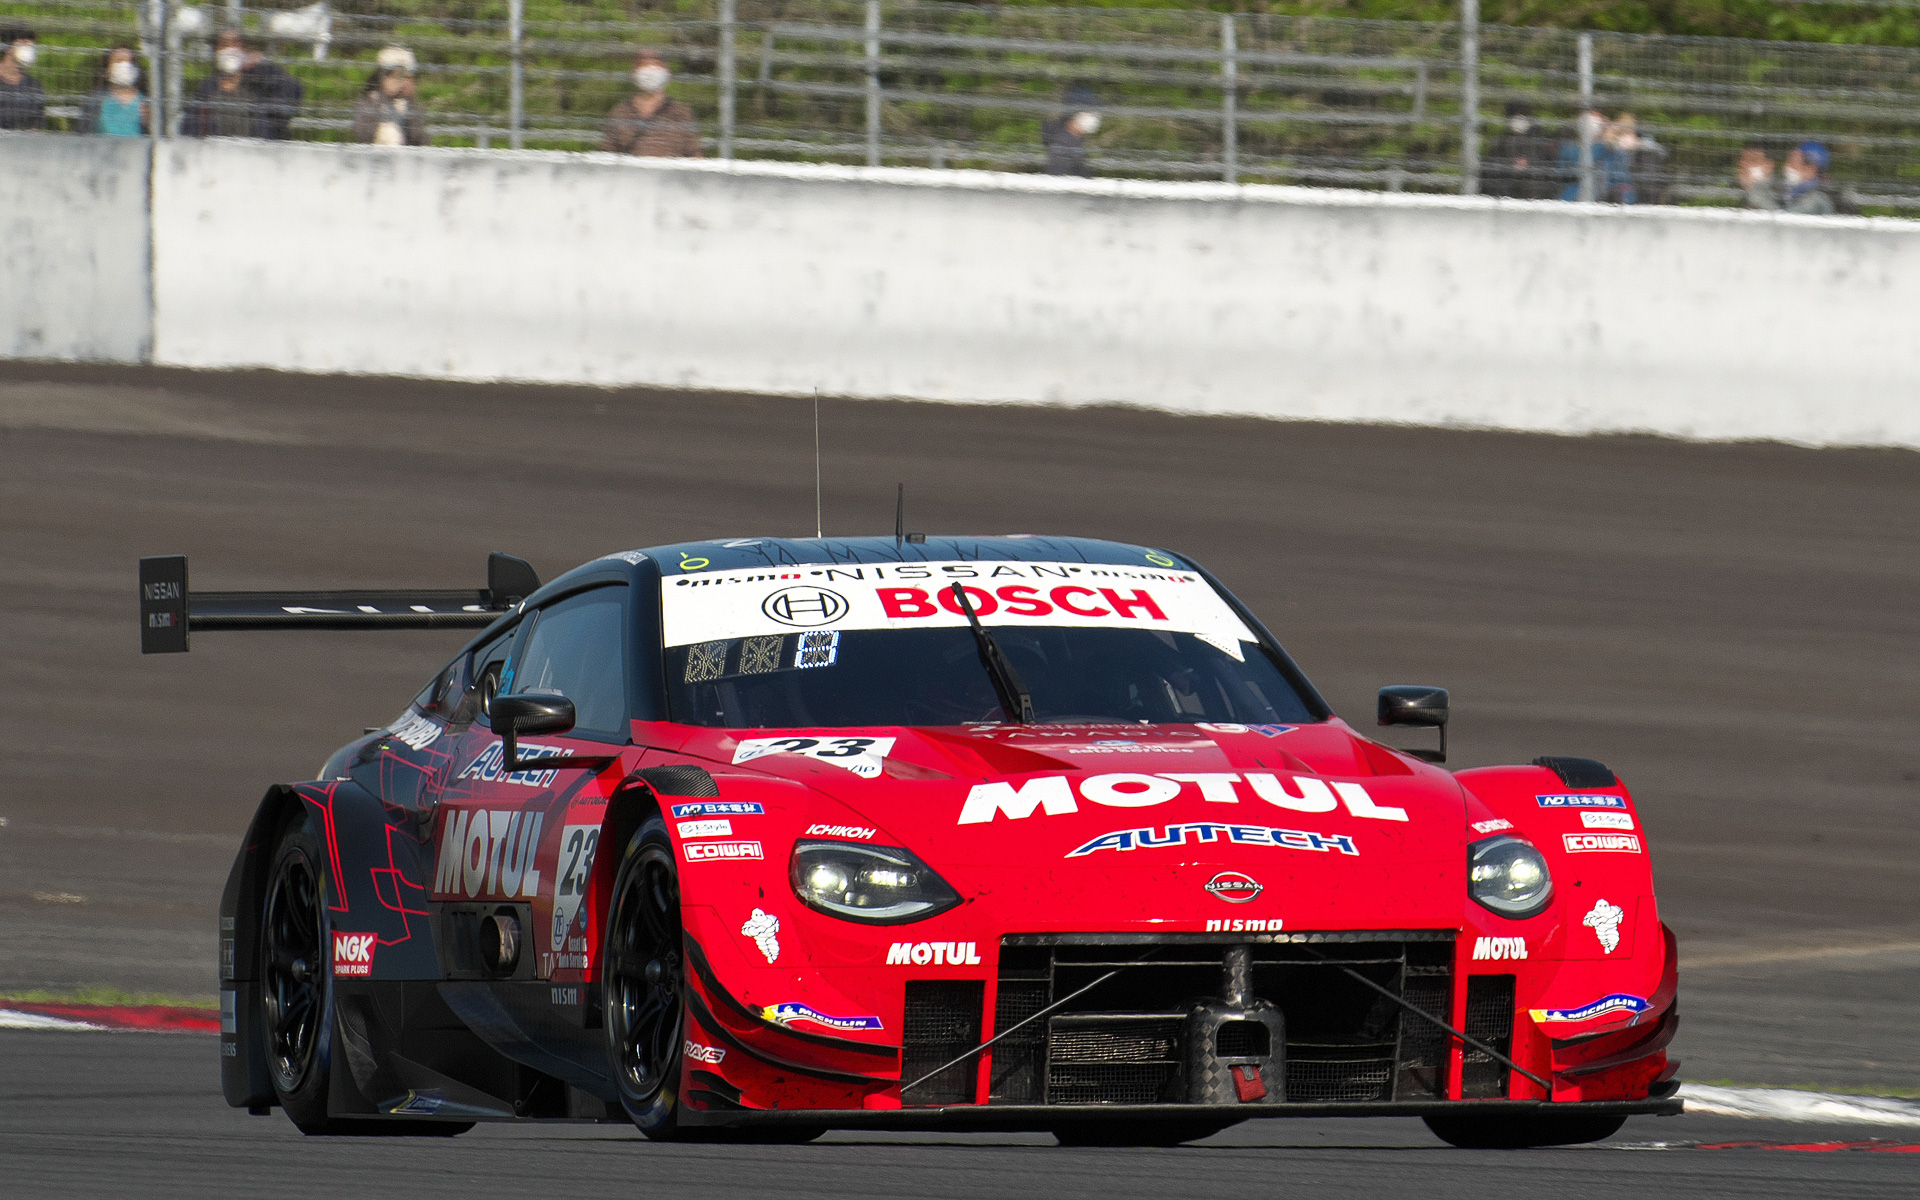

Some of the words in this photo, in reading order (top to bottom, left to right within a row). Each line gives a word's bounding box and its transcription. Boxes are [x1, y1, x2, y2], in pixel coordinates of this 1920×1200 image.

[691, 573, 801, 588] nismo
[825, 565, 1071, 582] NISSAN
[1091, 570, 1185, 583] nismo
[144, 581, 180, 600] NISSAN
[875, 585, 1170, 621] BOSCH
[769, 739, 876, 757] 23
[957, 773, 1410, 824] MOTUL
[805, 823, 877, 840] ICHIKOH
[1064, 821, 1360, 857] AUTECH
[434, 809, 545, 899] MOTUL
[559, 828, 600, 897] 23
[1204, 881, 1264, 892] NISSAN
[1205, 919, 1284, 933] nismo
[335, 935, 374, 962] NGK
[885, 941, 982, 966] MOTUL
[1472, 936, 1529, 961] MOTUL
[350, 964, 369, 974] PLUGS
[551, 987, 586, 1006] nismo
[798, 1007, 868, 1028] MICHELIN
[1568, 998, 1638, 1020] MICHELIN
[684, 1040, 726, 1064] RAYS
